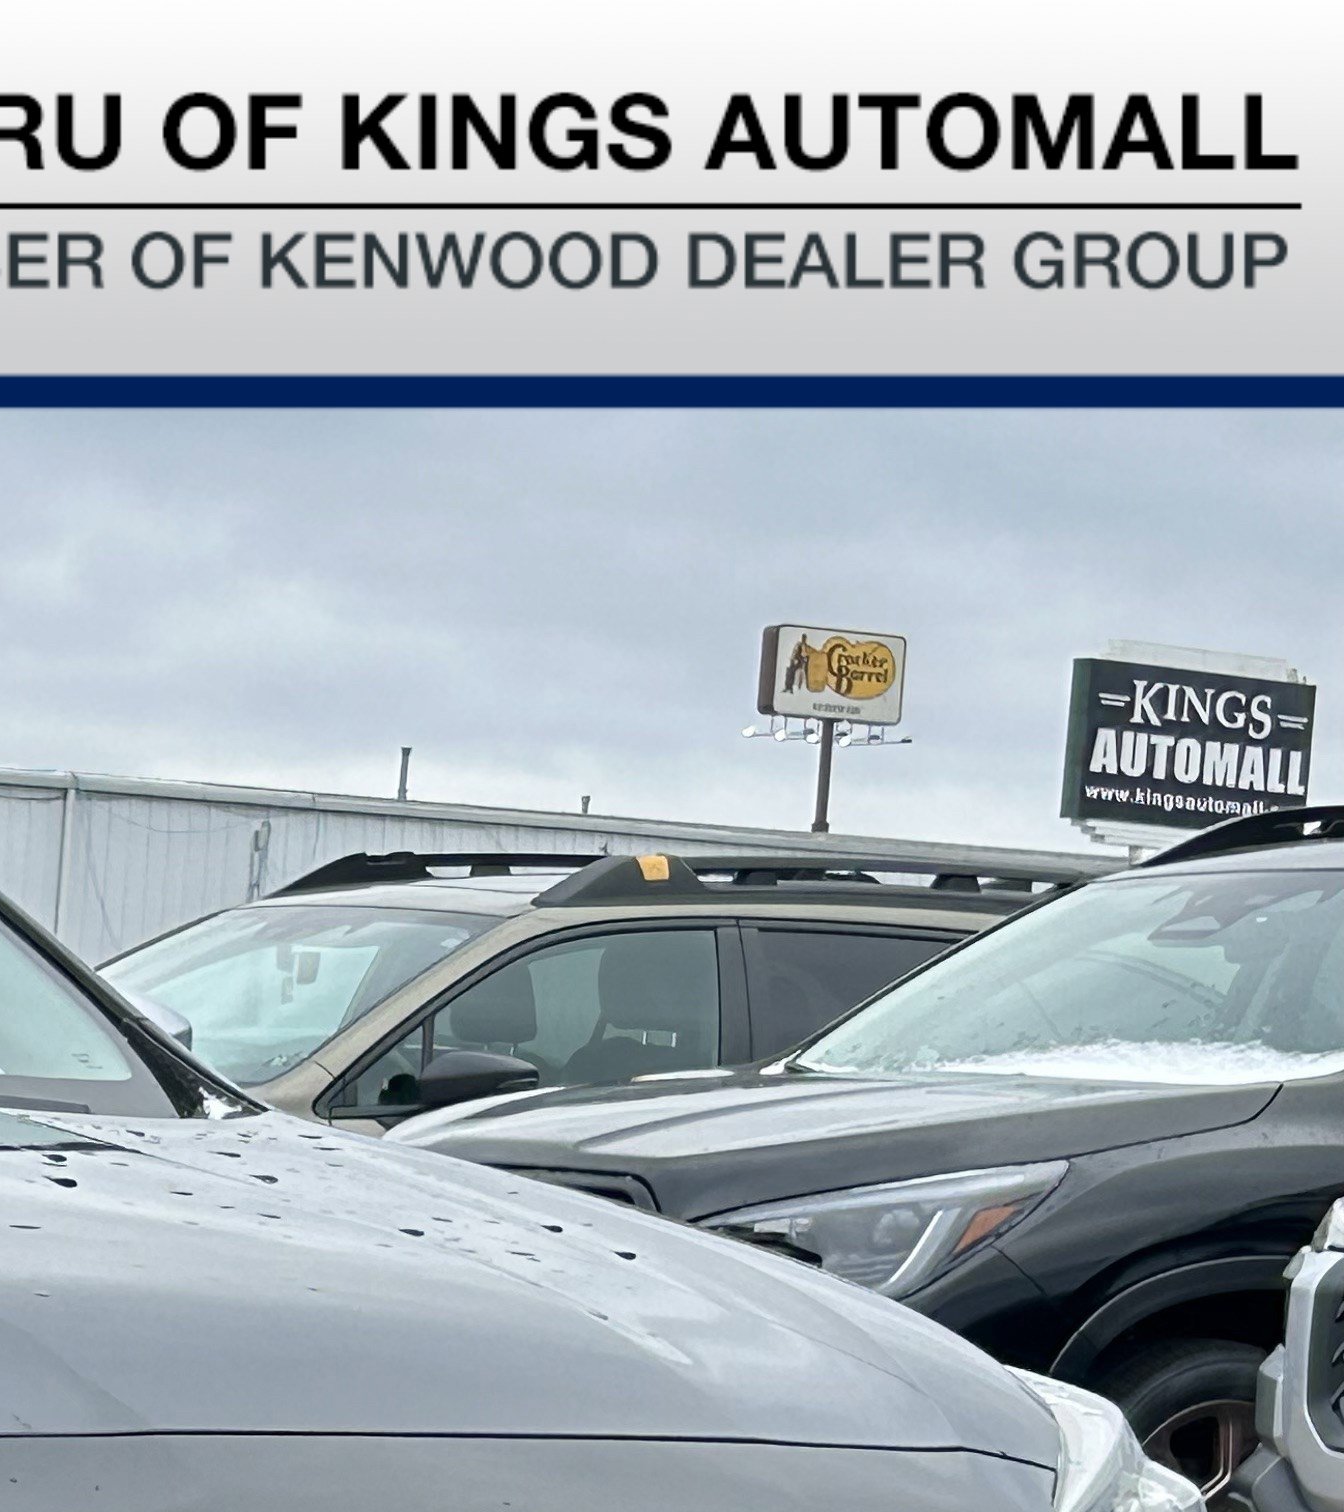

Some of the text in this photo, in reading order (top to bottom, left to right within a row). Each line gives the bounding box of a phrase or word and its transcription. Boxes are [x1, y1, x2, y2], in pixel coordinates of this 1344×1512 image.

[835, 665, 889, 694] Barrel
[1129, 679, 1273, 740] KINGS
[1089, 727, 1306, 795] AUTOMALL
